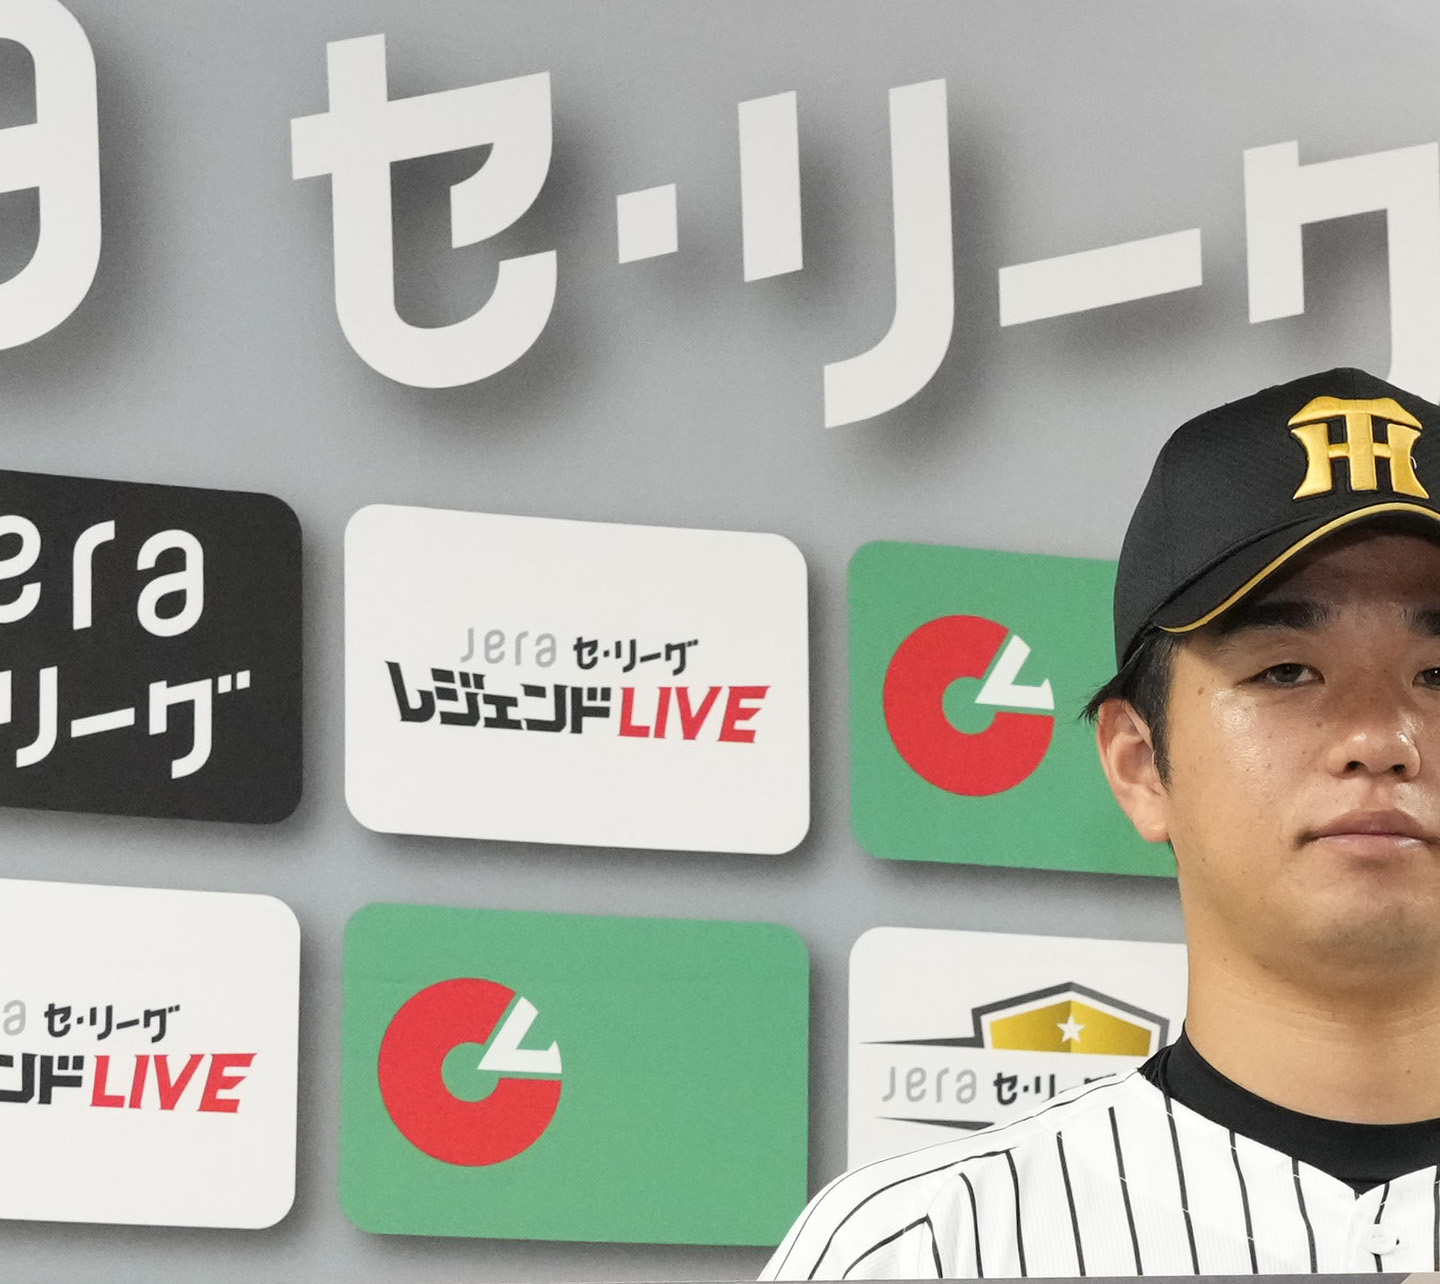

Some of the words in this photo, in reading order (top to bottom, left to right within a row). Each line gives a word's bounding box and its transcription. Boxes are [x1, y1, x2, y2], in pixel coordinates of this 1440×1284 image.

[0, 515, 204, 637] era
[573, 637, 698, 676] セ・リーグ
[0, 666, 250, 779] リーグ
[44, 1003, 180, 1043] セ・リーグ
[0, 1053, 257, 1113] ンドLIVE
[993, 1072, 1117, 1106] セ・リ
